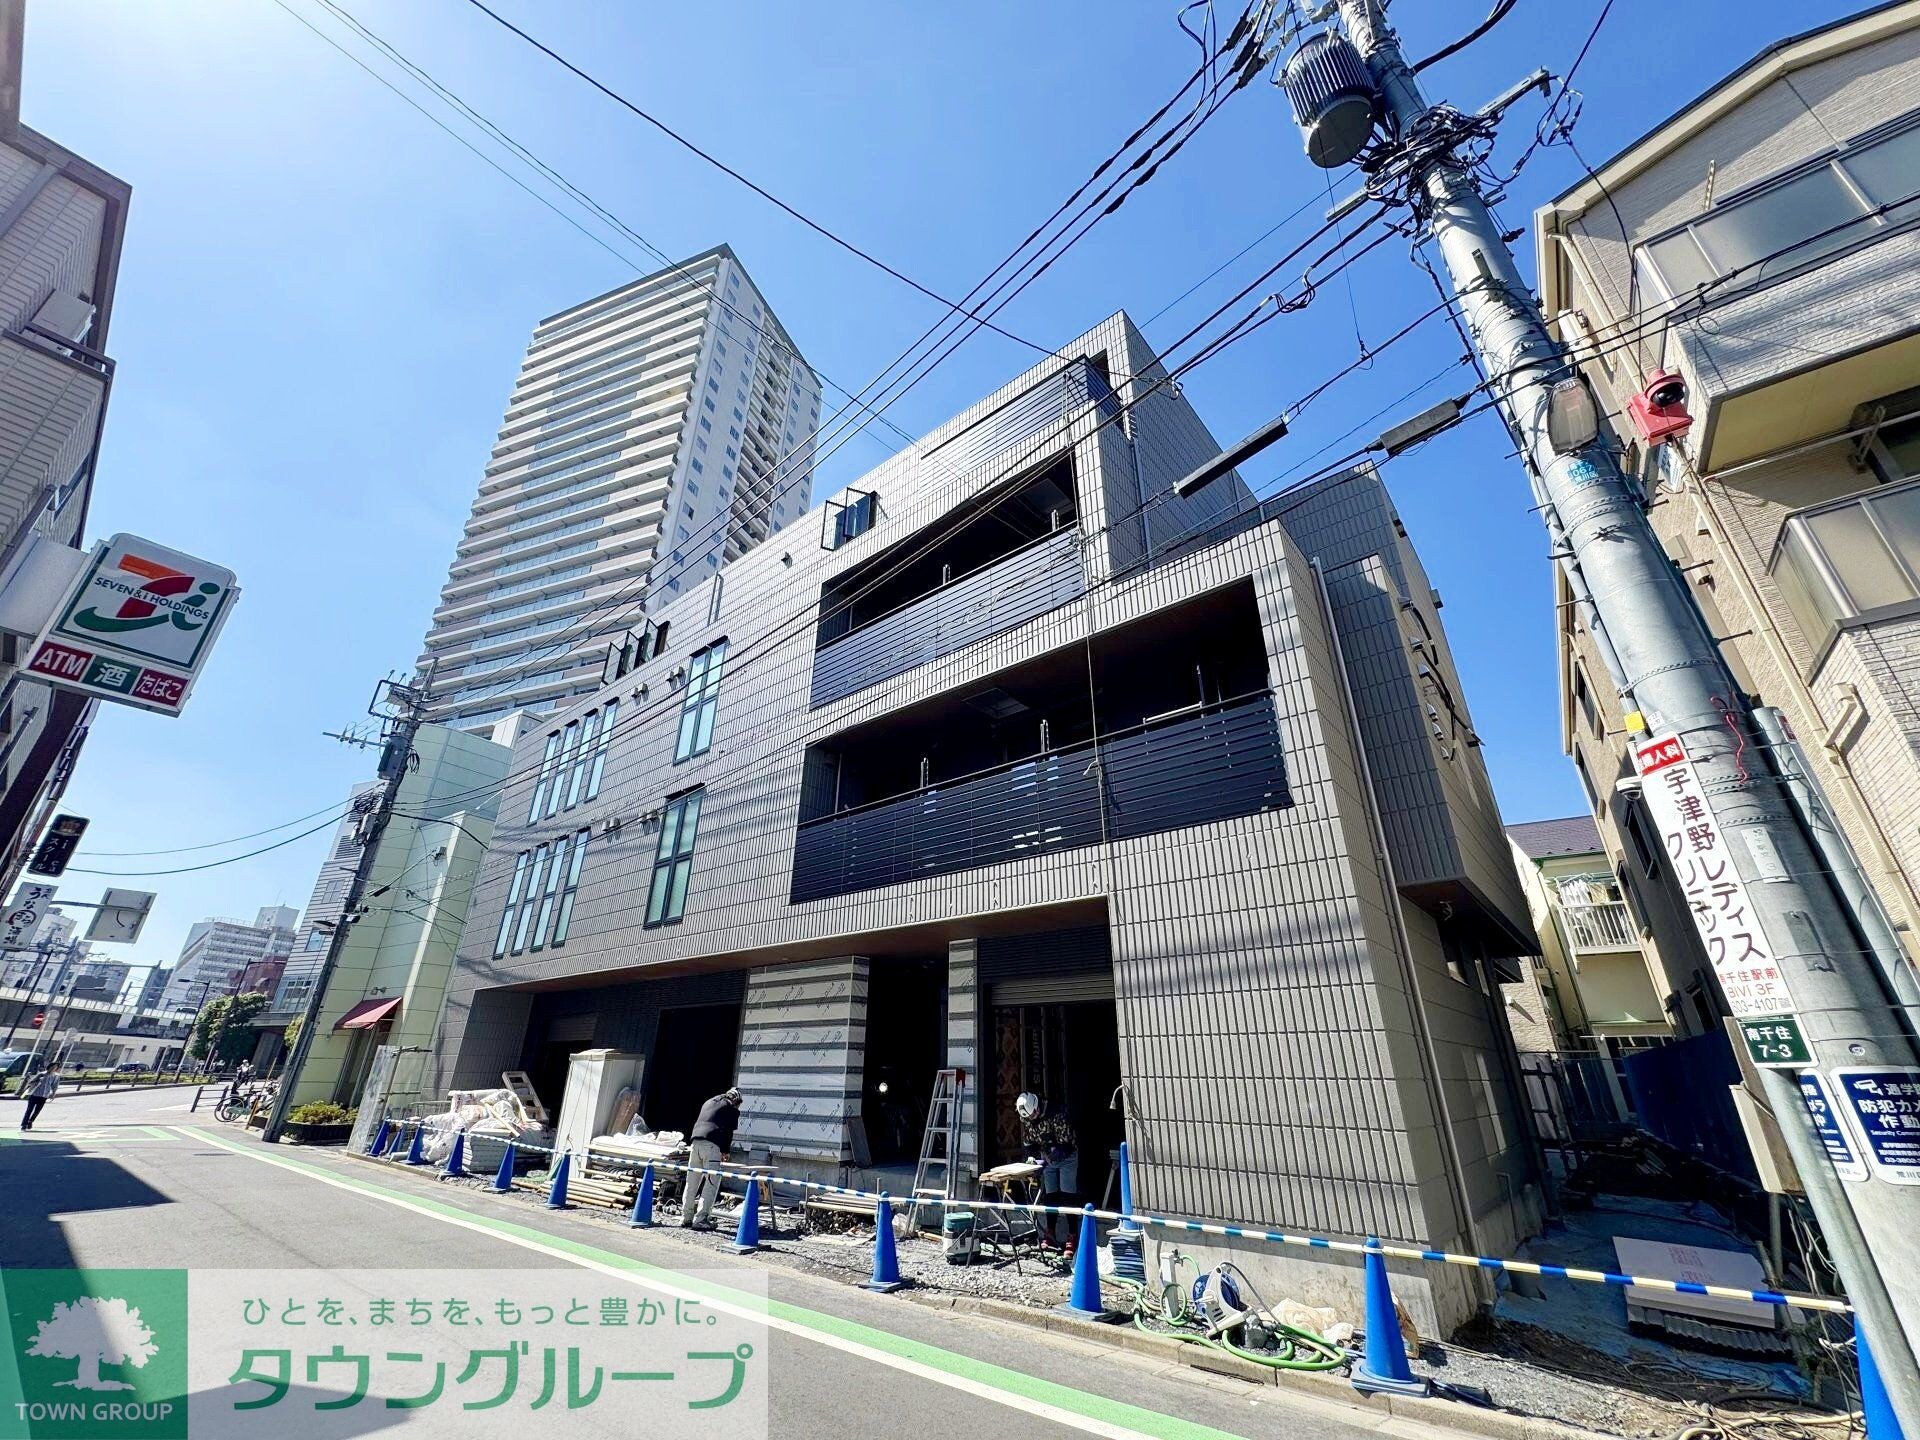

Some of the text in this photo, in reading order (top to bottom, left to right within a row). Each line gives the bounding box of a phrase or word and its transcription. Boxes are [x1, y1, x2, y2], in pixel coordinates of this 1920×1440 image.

[150, 594, 210, 620] HOLDINGS
[36, 647, 87, 677] ATM
[93, 662, 129, 688] 酒
[136, 673, 183, 701] たばこ
[1663, 767, 1767, 962] 宇津野レディス
[1667, 832, 1726, 966] クリニック
[1755, 983, 1775, 996] 3F
[1745, 1026, 1793, 1041] 南千住
[1758, 1044, 1792, 1058] 7-3
